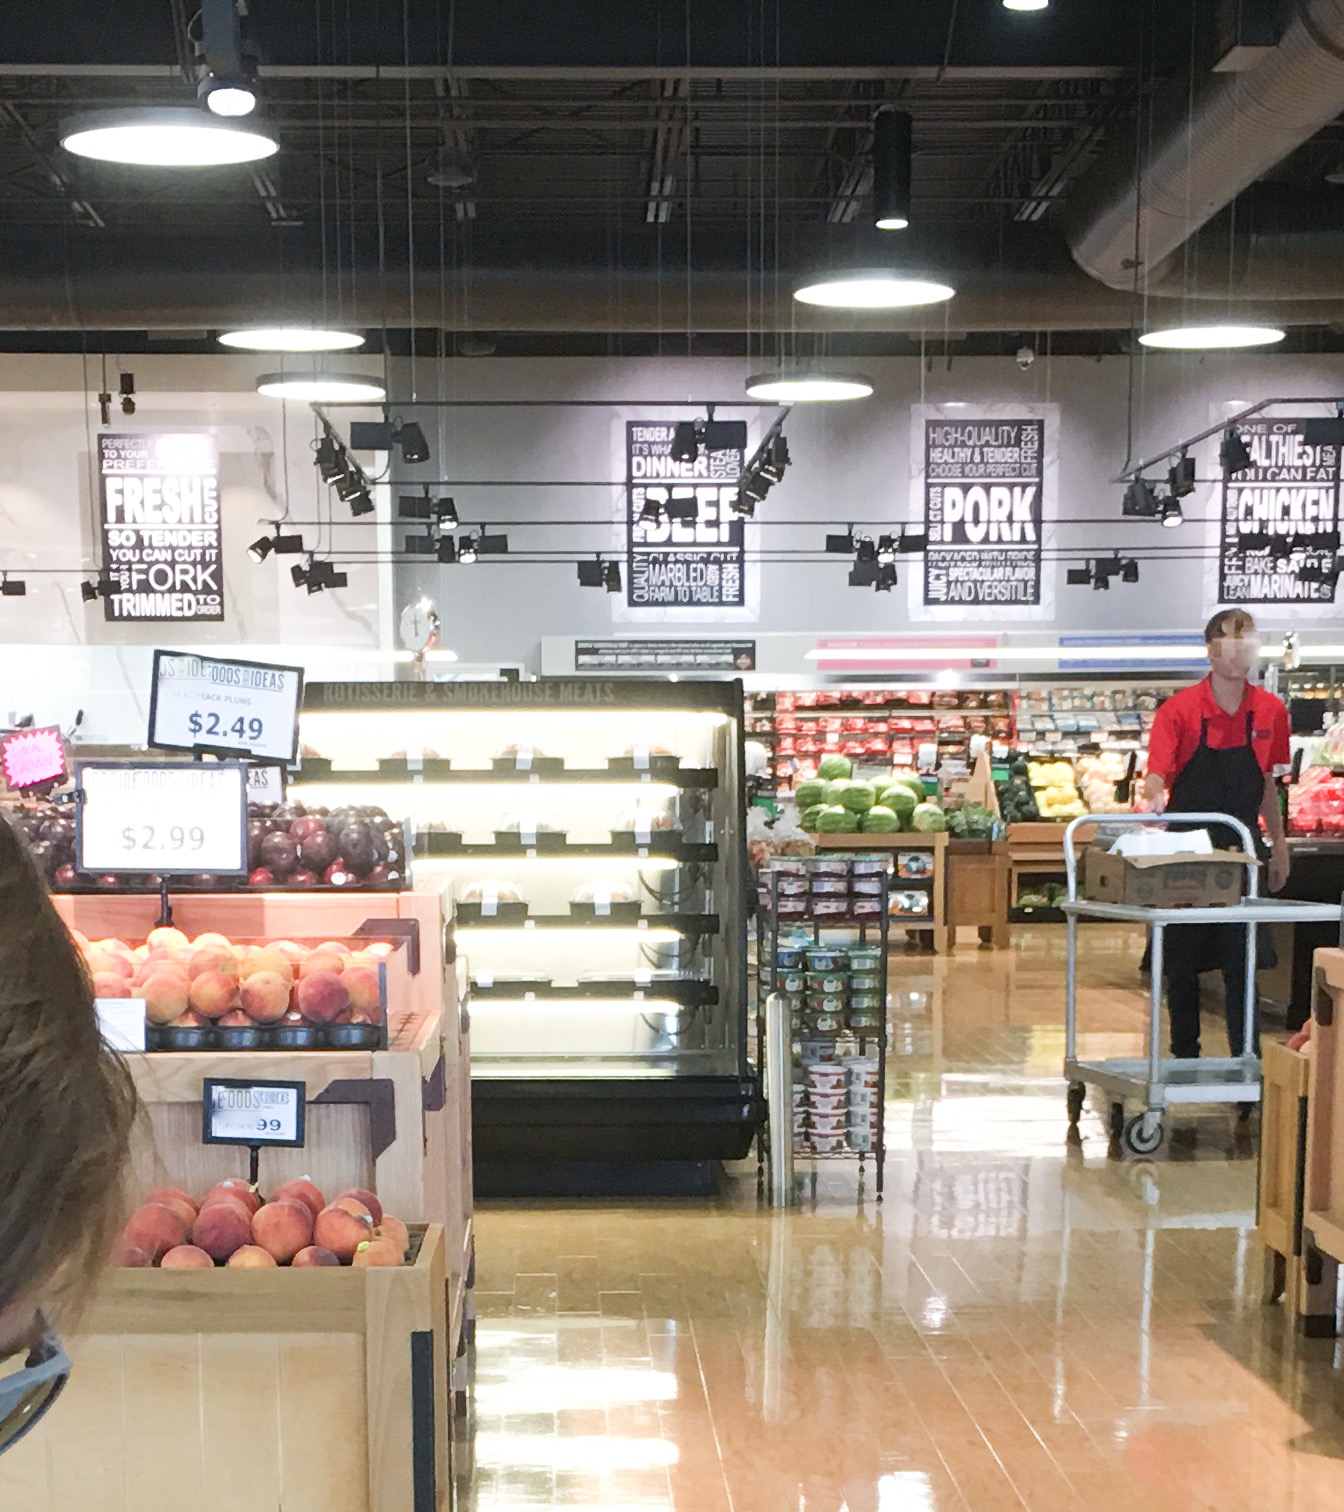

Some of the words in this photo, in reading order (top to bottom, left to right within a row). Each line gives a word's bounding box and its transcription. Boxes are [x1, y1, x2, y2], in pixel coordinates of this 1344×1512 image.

[632, 427, 668, 442] TENDER
[929, 425, 1018, 446] HIGH-QUALITY
[1236, 424, 1267, 434] ONE
[1272, 424, 1297, 433] OF
[103, 449, 118, 459] TO
[119, 449, 149, 459] YOUR
[1020, 425, 1039, 463] FRESH
[1240, 434, 1322, 467] ALTHIES
[710, 449, 727, 479] STEA
[930, 447, 971, 463] HEALTHY
[973, 447, 981, 462] &
[983, 447, 1020, 463] TENDER
[632, 456, 707, 478] DINNER
[929, 464, 962, 477] CHOOSE
[965, 464, 985, 477] YOUR
[986, 464, 1020, 477] PERFECT
[1021, 464, 1037, 476] CUT
[1267, 467, 1303, 480] CAN
[105, 477, 203, 524] FRESH
[203, 477, 218, 524] CUTS
[632, 487, 646, 512] CUTS
[928, 486, 942, 507] CUTS
[645, 486, 740, 542] BEEF
[943, 485, 1037, 542] PORK
[1238, 488, 1335, 535] CHICKEN
[107, 530, 136, 547] SO
[140, 530, 218, 547] TENDER
[109, 549, 139, 562] YOU
[142, 549, 173, 562] CAN
[174, 549, 204, 562] CUT
[205, 549, 218, 561] IT
[1245, 557, 1274, 573] BAKE
[131, 563, 218, 591] FORK
[632, 553, 649, 602] QUALITY
[648, 563, 706, 586] MARBLED
[721, 563, 740, 602] FRESH
[928, 567, 947, 601] JUICY
[948, 567, 1004, 581] SPECTACULAR
[1005, 567, 1036, 581] FLAVOR
[196, 594, 221, 605] TO
[649, 587, 675, 602] FARM
[677, 587, 689, 602] TO
[692, 587, 720, 602] TABLE
[947, 581, 976, 601] AND
[977, 581, 1035, 601] VERSITILE
[109, 593, 197, 617] TRIMMED
[196, 604, 222, 615] ORDER
[250, 670, 285, 690] IDEAS
[323, 683, 417, 701] ROTISSERIE
[425, 683, 437, 700] &
[443, 683, 553, 701] SMOKEHOUSE
[560, 683, 615, 701] MEATS
[188, 710, 263, 740] $2.49
[121, 825, 205, 854] $2.99
